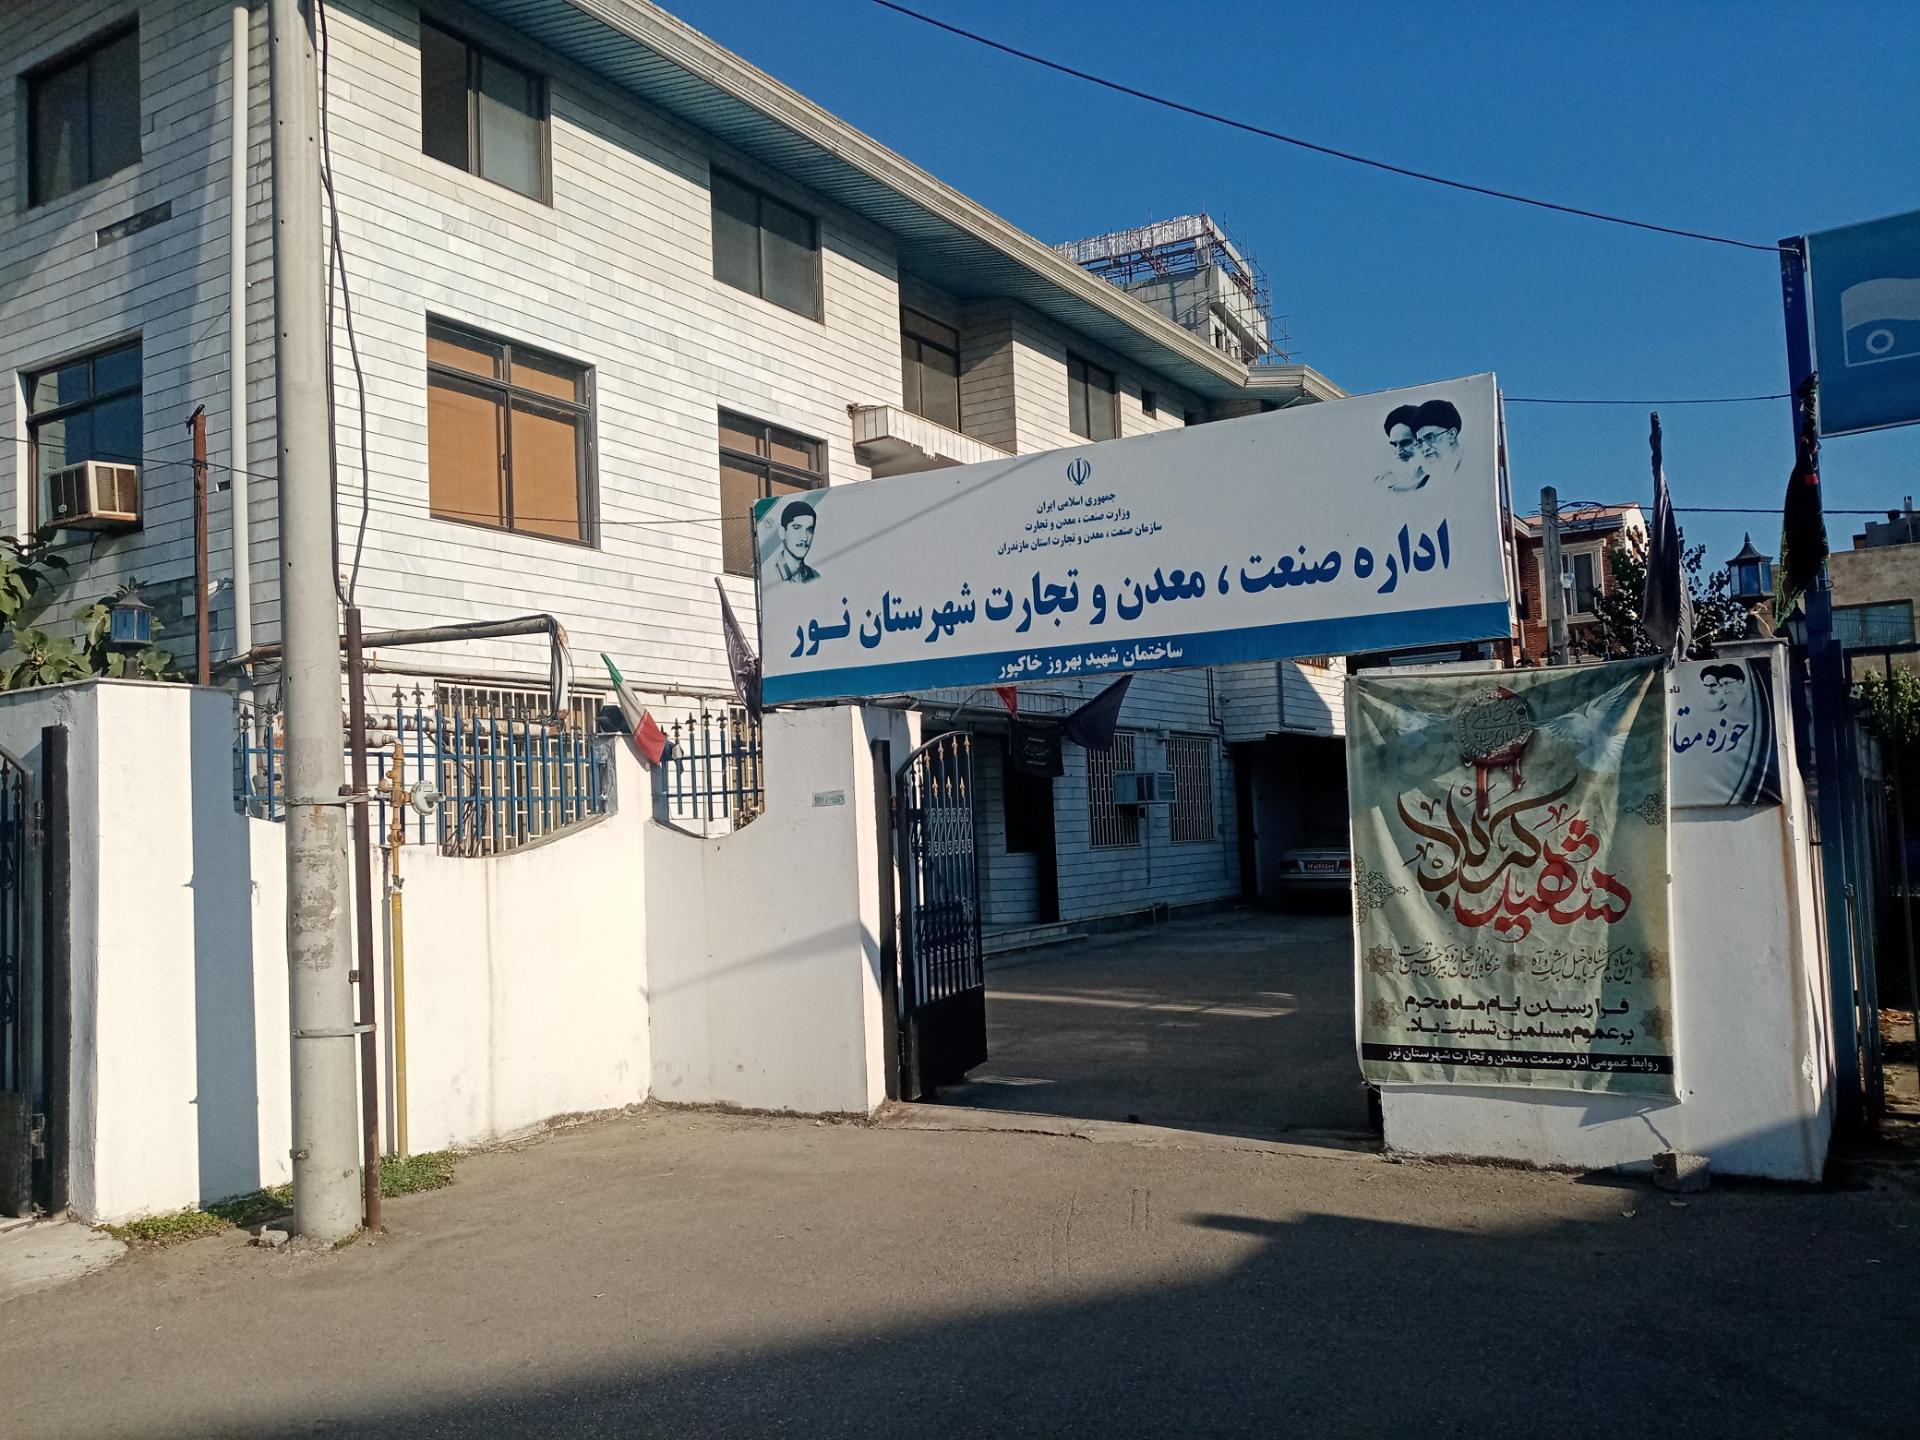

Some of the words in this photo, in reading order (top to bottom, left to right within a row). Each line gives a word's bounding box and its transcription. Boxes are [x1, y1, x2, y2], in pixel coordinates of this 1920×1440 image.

[1036, 500, 1056, 514] ایران
[1057, 495, 1083, 511] اسلامی
[1085, 492, 1116, 507] جمهوری
[1083, 511, 1105, 523] صنعت
[1105, 508, 1131, 521] وزارت
[1025, 520, 1048, 533] تجارت
[1049, 522, 1054, 530] و
[1055, 516, 1076, 529] معدن
[1134, 521, 1163, 537] سازمان
[1083, 532, 1104, 544] معدن
[1111, 527, 1133, 537] صنعت
[997, 540, 1029, 555] مازندران
[1030, 537, 1051, 551] استان
[1052, 533, 1076, 548] تجارت
[1077, 536, 1082, 545] و
[1353, 517, 1451, 594] اداره
[1240, 544, 1342, 594] صنعت
[985, 568, 1079, 633] تجارت
[1117, 567, 1206, 621] معدن
[1089, 583, 1107, 625] و
[859, 582, 977, 649] شهرستان
[790, 597, 851, 658] نور
[1085, 646, 1119, 669] شهید
[1122, 641, 1184, 668] ساختمان
[998, 655, 1042, 679] خاکپور
[1046, 653, 1082, 676] بهروز
[1672, 706, 1702, 754] مقا
[1706, 718, 1750, 754] حوزه
[1387, 1047, 1402, 1059] نور
[1402, 1049, 1450, 1061] شهرستان
[1452, 1051, 1486, 1063] تجارت
[1487, 1056, 1493, 1064] و
[1495, 1055, 1524, 1066] معدن
[1566, 1055, 1589, 1068] اداره
[1591, 1058, 1627, 1071] عمومی
[1631, 1057, 1659, 1072] روابط
